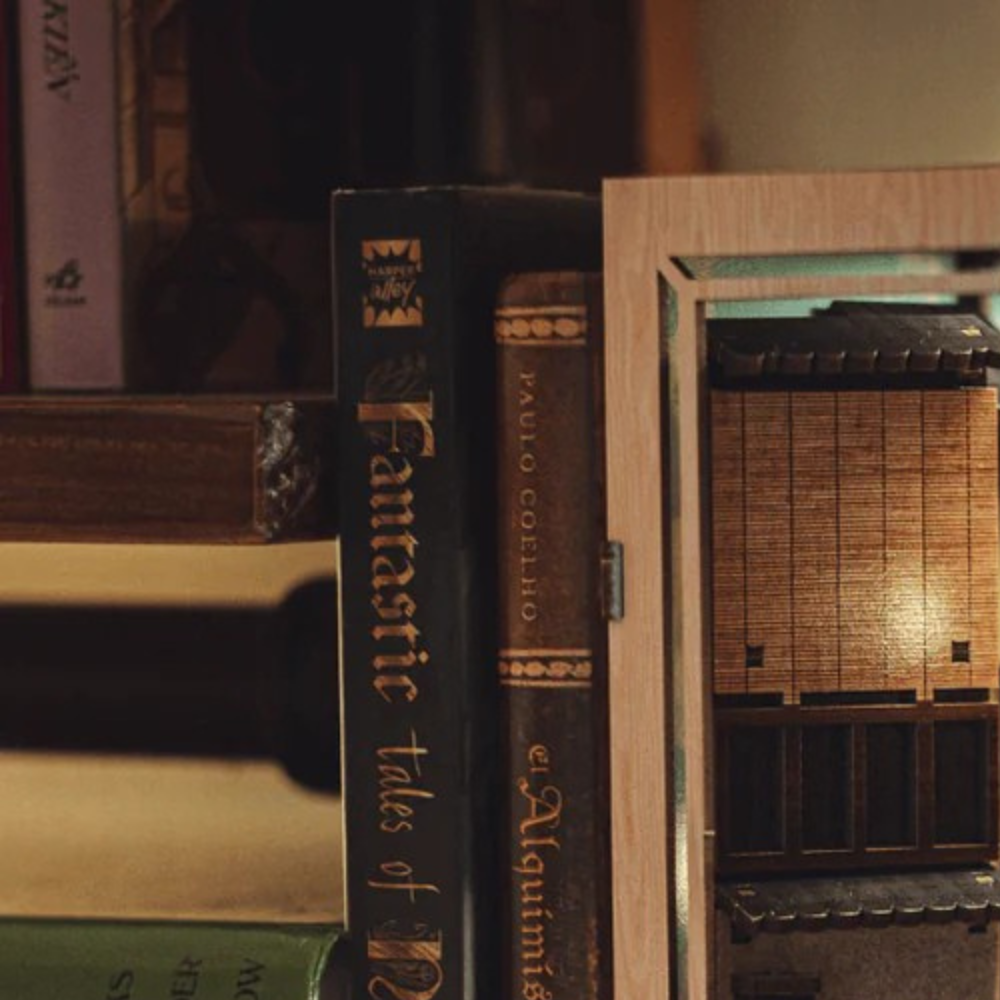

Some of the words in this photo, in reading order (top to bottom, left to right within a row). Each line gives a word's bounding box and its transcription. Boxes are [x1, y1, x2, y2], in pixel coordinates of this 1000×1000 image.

[519, 372, 537, 473] PAULO
[357, 390, 435, 702] Fantastic
[520, 488, 538, 621] COELHO
[375, 726, 435, 833] tales
[367, 861, 441, 903] of
